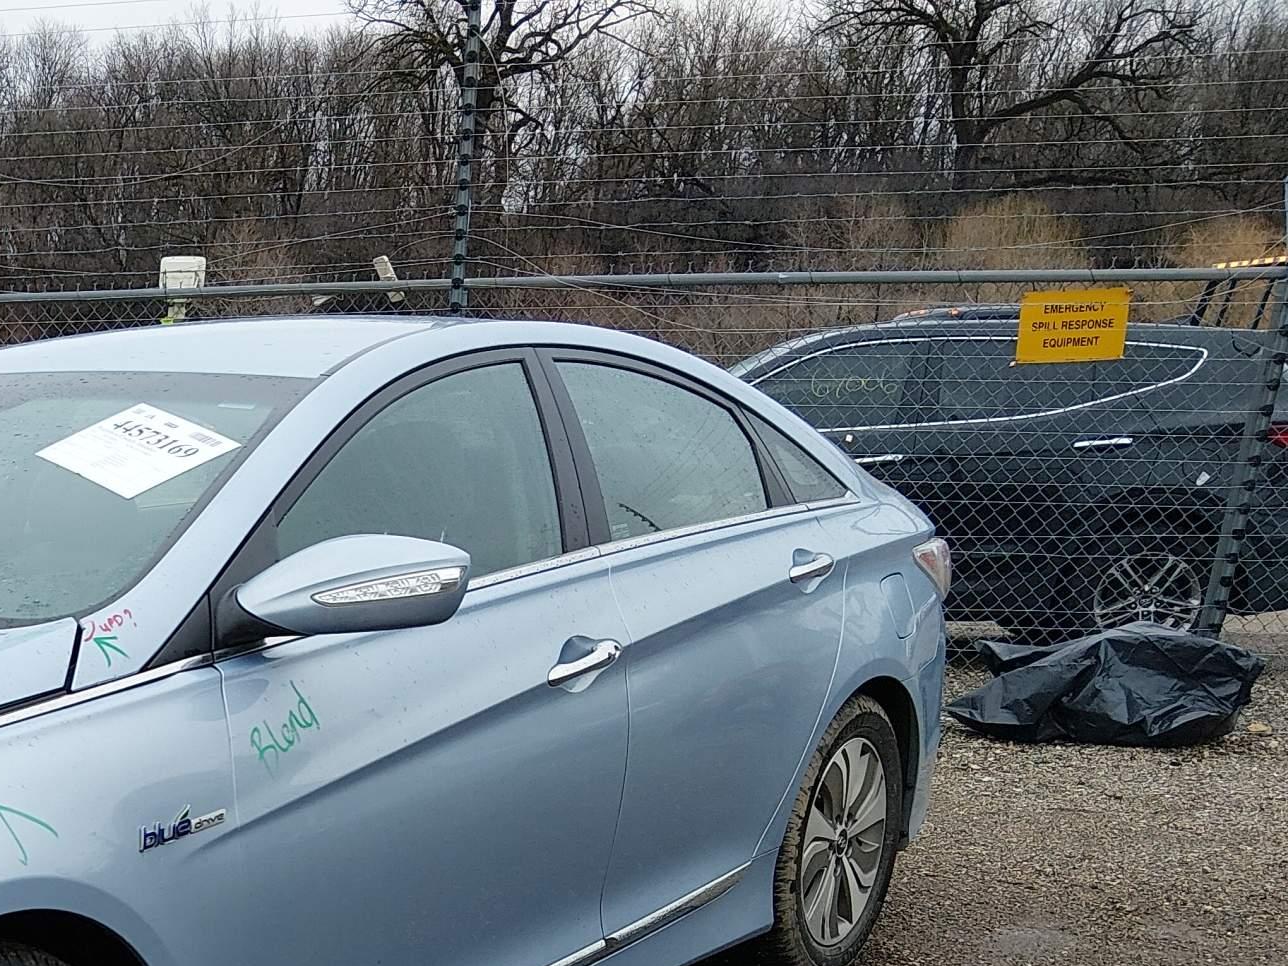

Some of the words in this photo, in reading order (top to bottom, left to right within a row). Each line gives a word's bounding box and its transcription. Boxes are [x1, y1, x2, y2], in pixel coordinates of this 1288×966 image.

[1043, 301, 1107, 314] EMERGENCY
[1031, 321, 1058, 332] SPILL
[1060, 318, 1115, 331] RESPONSE
[1042, 335, 1100, 348] EQUIPMENT
[114, 420, 199, 457] 44573169
[250, 679, 320, 773] Blend
[139, 807, 193, 852] blue
[193, 812, 226, 832] drive
